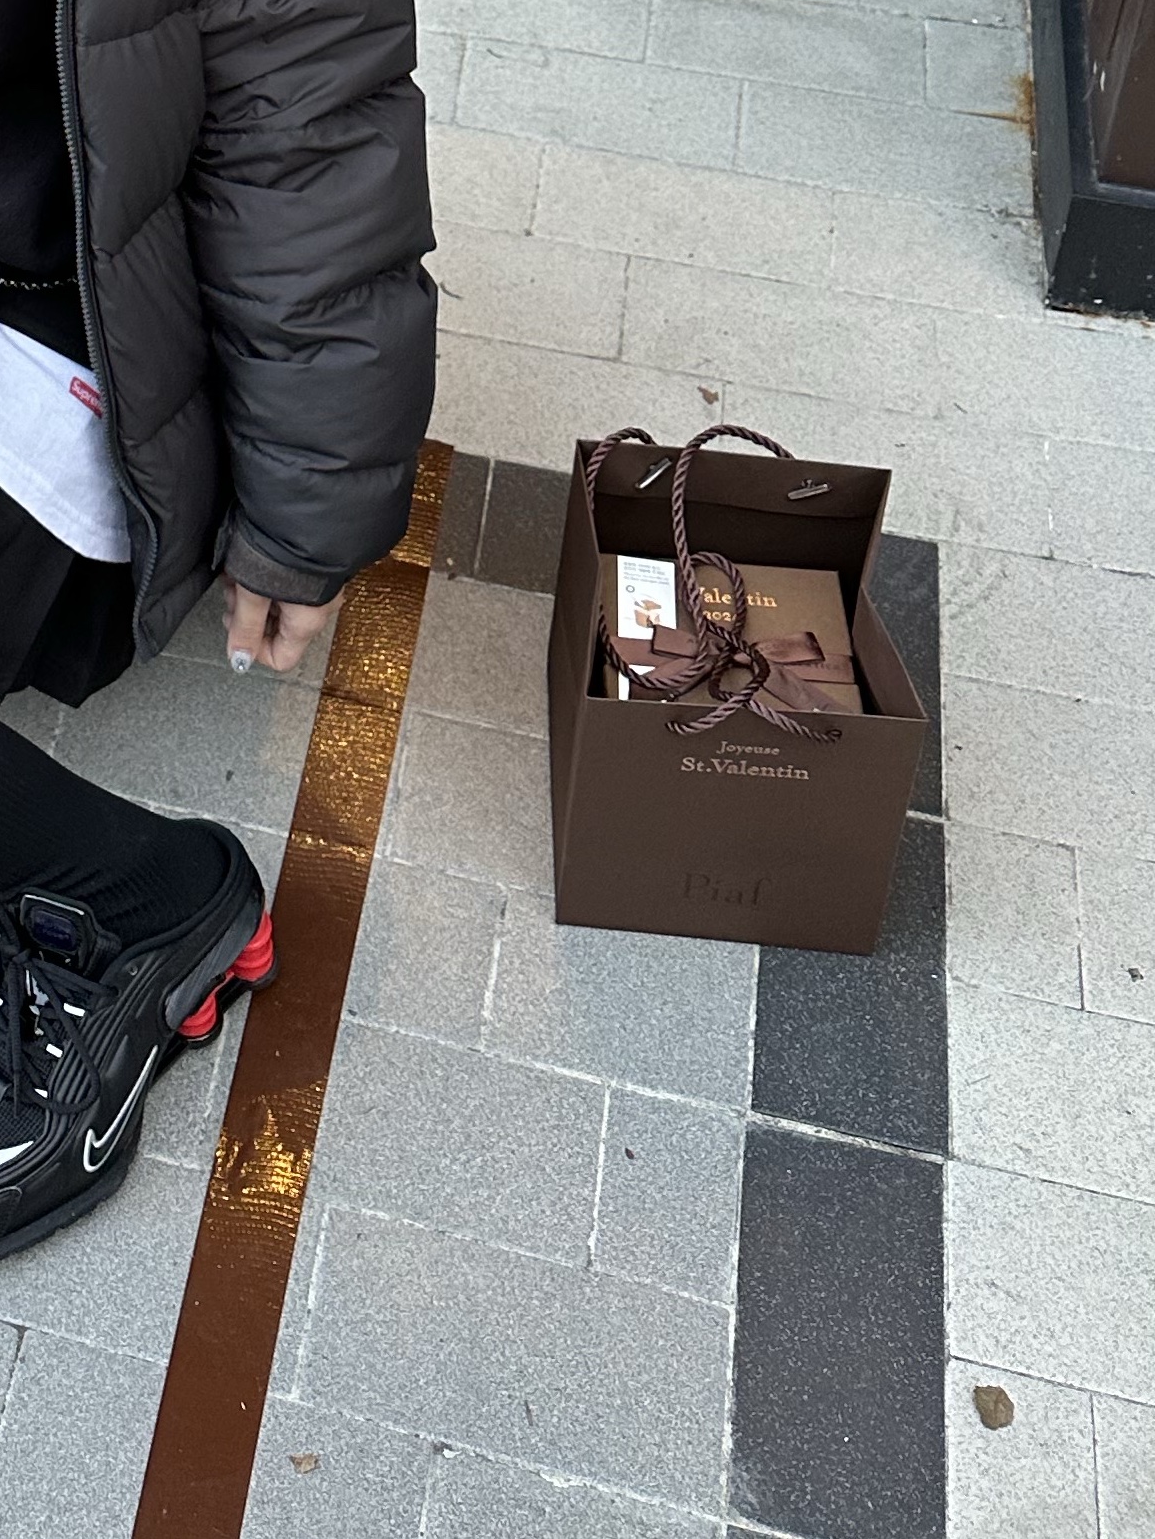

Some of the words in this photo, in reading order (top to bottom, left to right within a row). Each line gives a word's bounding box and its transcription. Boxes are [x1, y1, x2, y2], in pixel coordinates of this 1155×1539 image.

[699, 587, 777, 607] aletin
[716, 741, 780, 755] Joyeuse
[681, 757, 809, 780] St.Valentin
